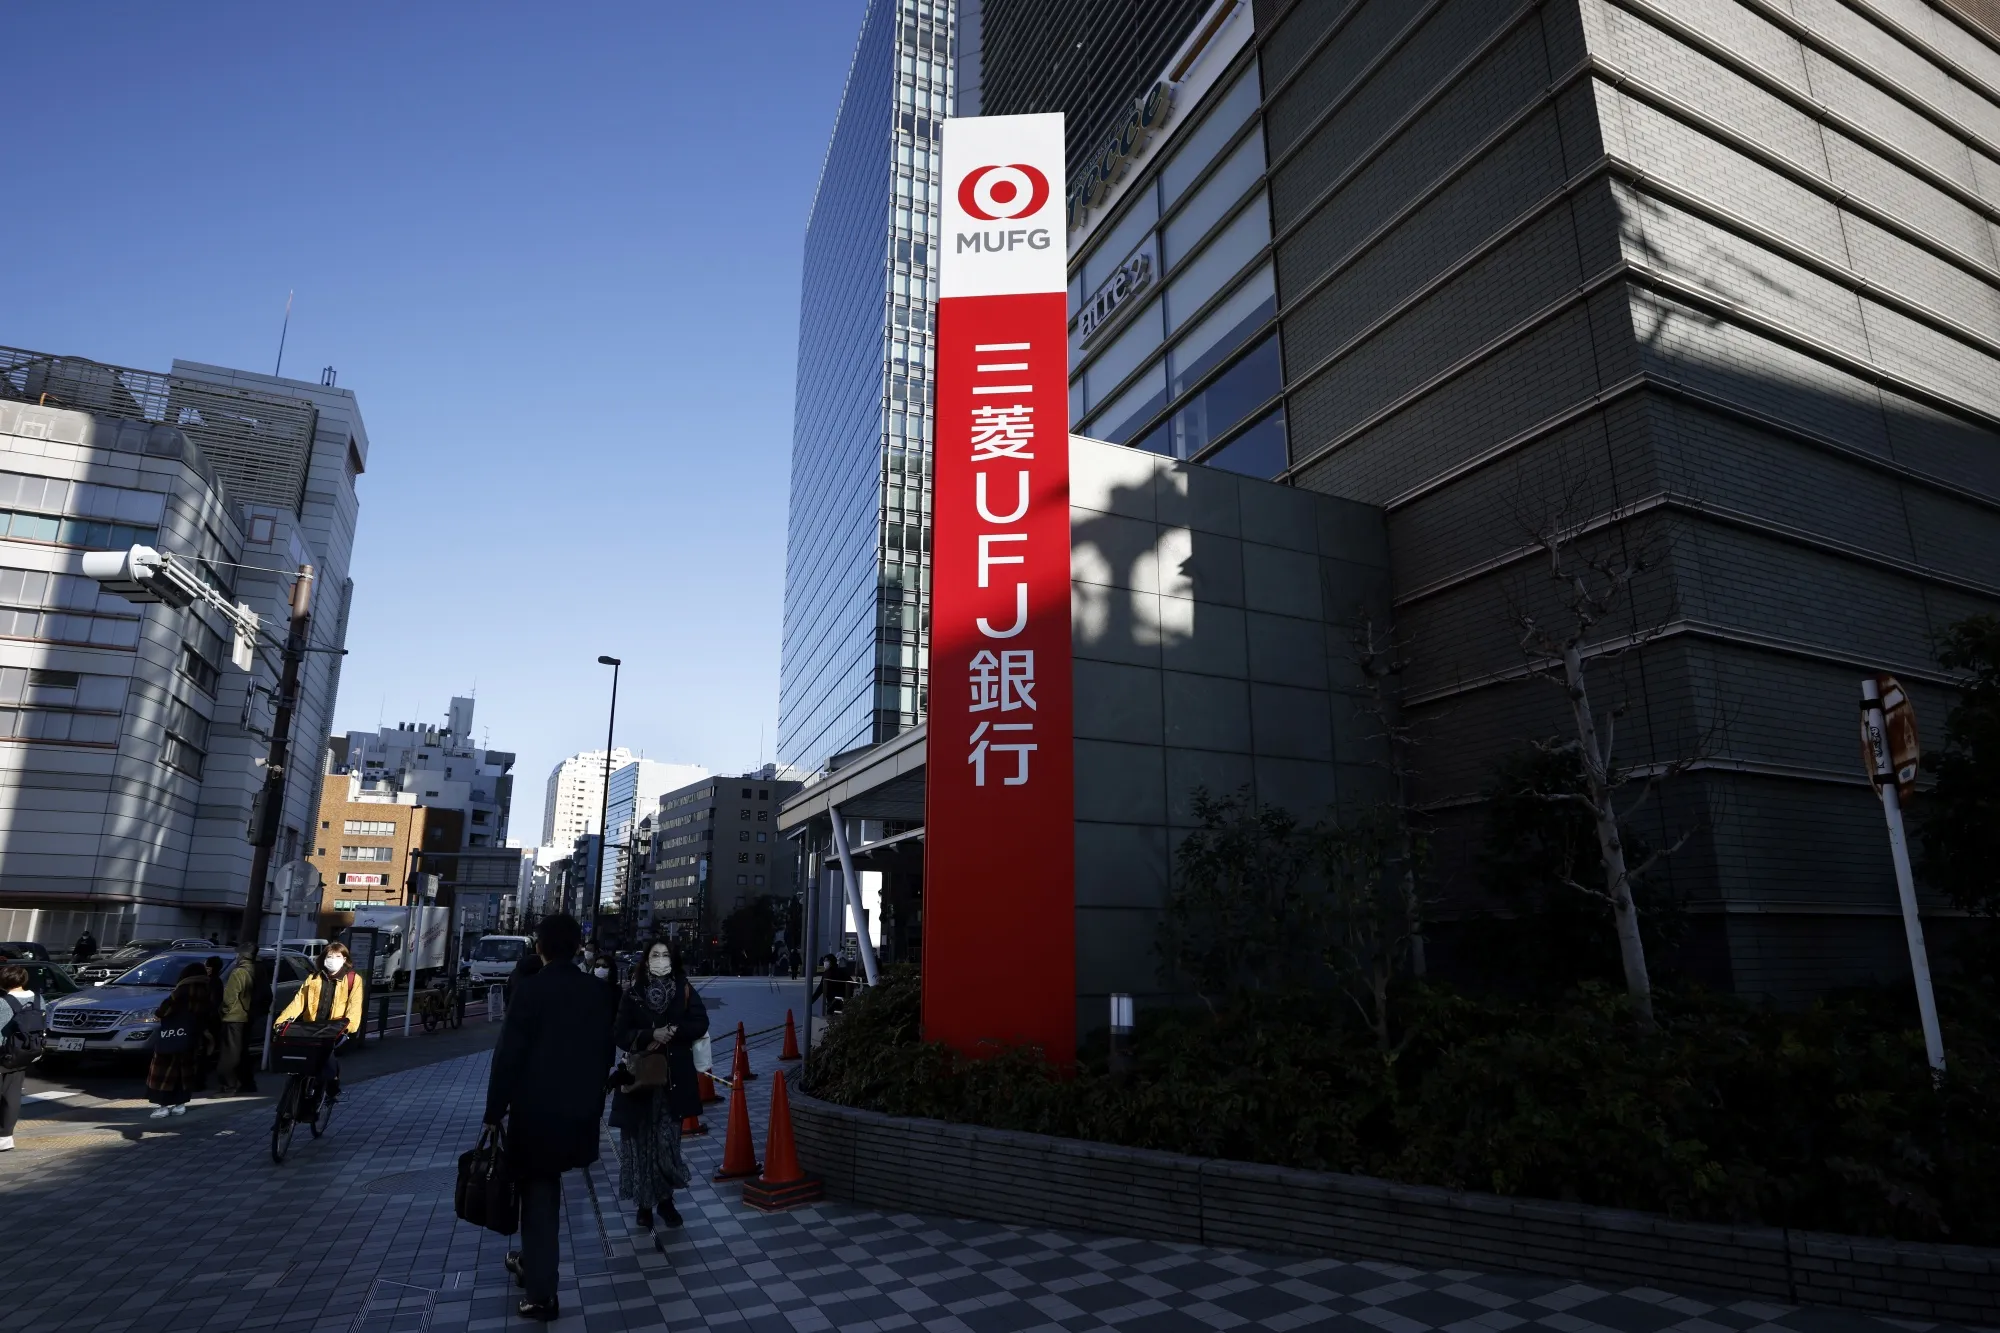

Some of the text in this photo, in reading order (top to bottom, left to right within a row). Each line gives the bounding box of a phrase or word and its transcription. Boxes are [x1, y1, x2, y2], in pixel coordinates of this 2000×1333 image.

[1066, 81, 1169, 231] recce
[957, 229, 1050, 254] MUFG
[968, 343, 1037, 786] 三菱UFJ銀行
